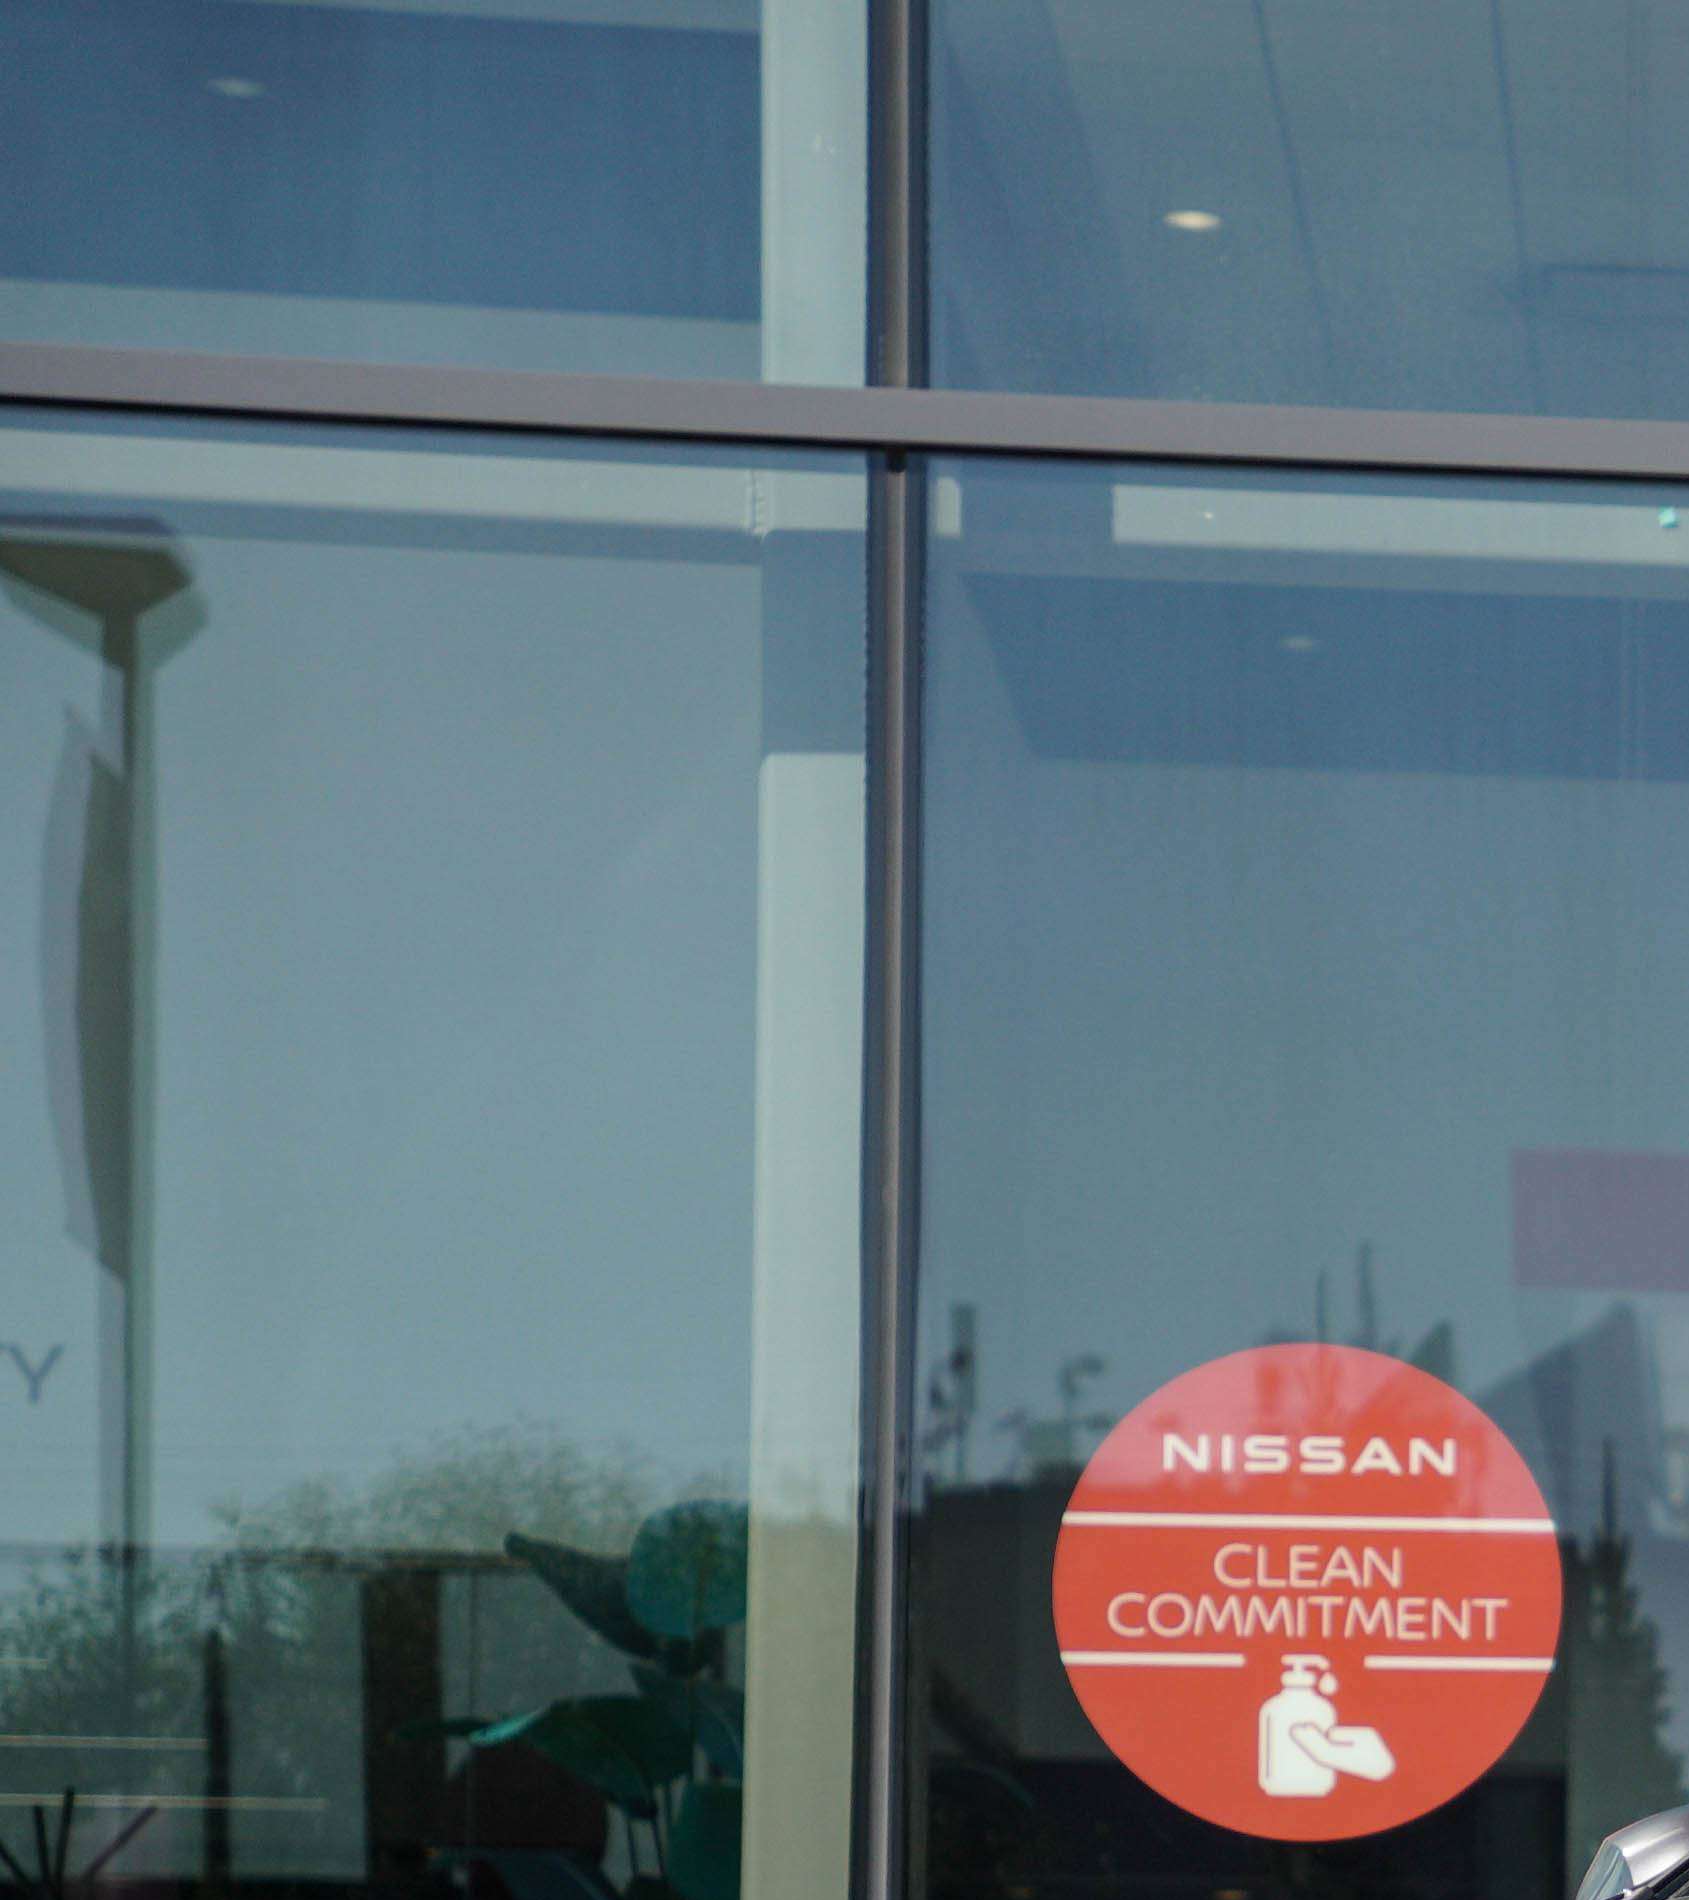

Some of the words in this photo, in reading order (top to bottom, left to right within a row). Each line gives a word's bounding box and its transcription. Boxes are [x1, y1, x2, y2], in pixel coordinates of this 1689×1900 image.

[1162, 1433, 1457, 1476] NISSAN
[1213, 1543, 1403, 1589] CLEAN
[1106, 1592, 1510, 1641] COMMITMENT
